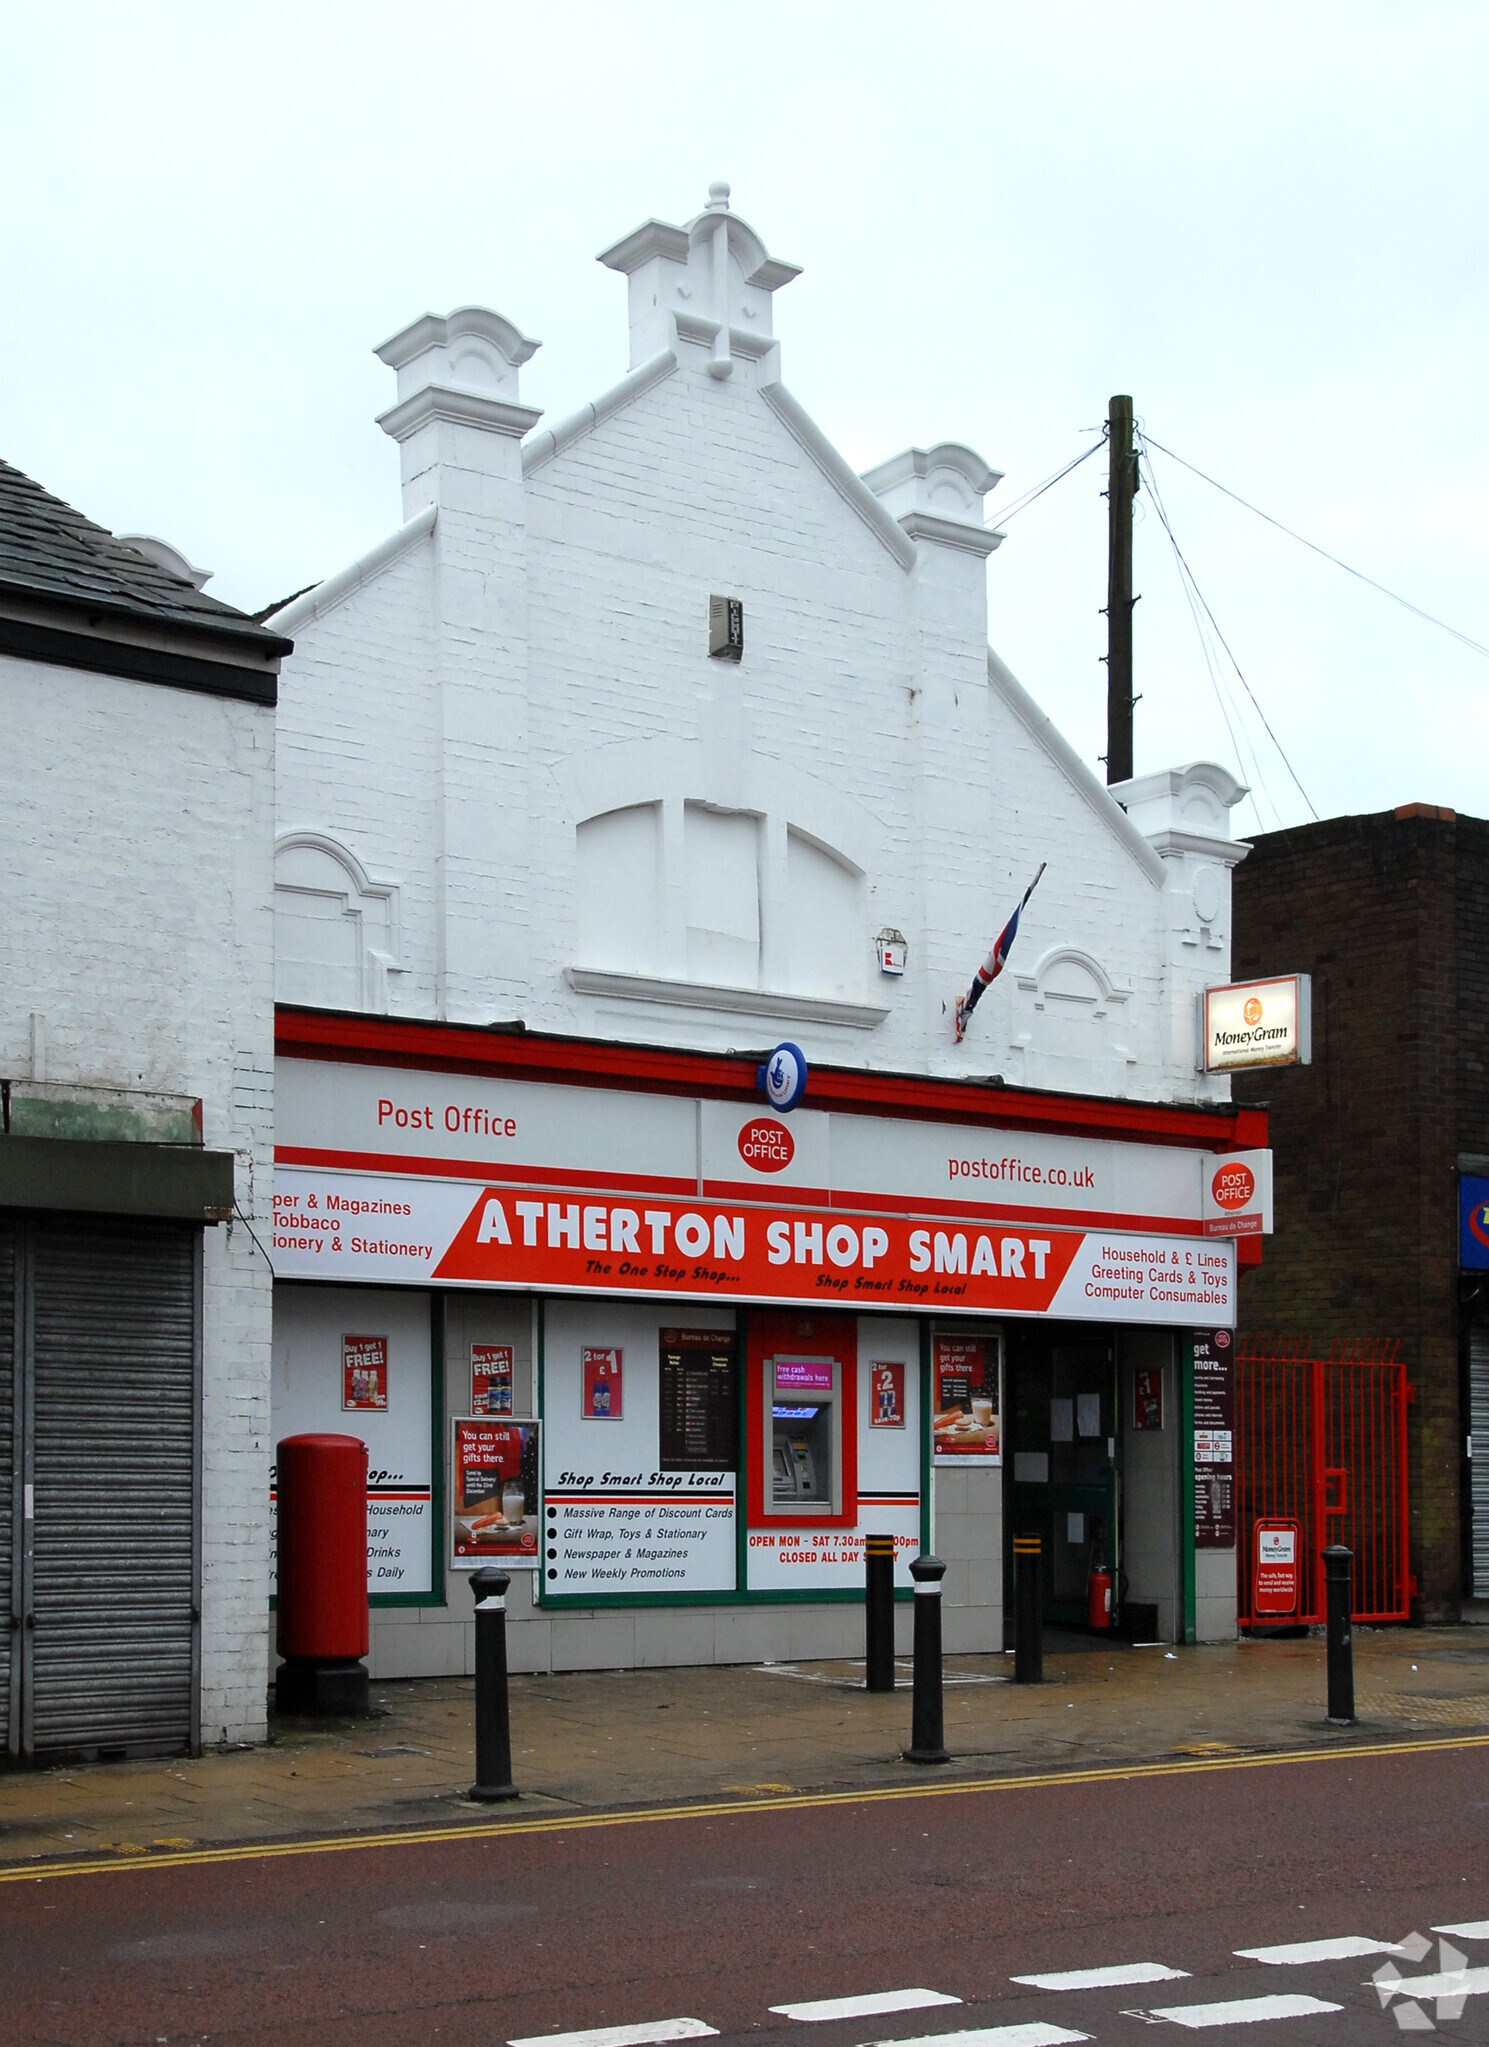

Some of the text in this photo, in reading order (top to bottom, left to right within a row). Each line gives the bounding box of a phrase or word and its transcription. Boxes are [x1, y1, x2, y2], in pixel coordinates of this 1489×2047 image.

[1214, 1027, 1288, 1046] MoneyGram
[378, 1099, 517, 1137] Post Office
[751, 1128, 784, 1144] POST
[743, 1143, 788, 1160] OFFICE
[948, 1158, 1095, 1188] postoffice.co.uk
[1221, 1173, 1247, 1187] POST
[1216, 1186, 1251, 1201] OFFICE
[272, 1193, 411, 1216] per & Magazines
[272, 1212, 341, 1231] Tobbaco
[1209, 1221, 1257, 1232] Bureau de Change
[476, 1198, 1051, 1279] ATHERTON SHOP SMART
[273, 1233, 433, 1260] ionery & Stationery
[1102, 1246, 1228, 1268] Household & £ Lines
[586, 1260, 741, 1284] The One Stop Shop...
[1091, 1264, 1228, 1288] Greeting Cards & Toys
[816, 1274, 967, 1296] Shop Smart Shop Local
[1085, 1283, 1228, 1305] Computer Consumables
[681, 1332, 702, 1341] Bureau
[710, 1334, 731, 1344] Change
[343, 1344, 358, 1353] Buy
[364, 1342, 376, 1352] get
[939, 1343, 976, 1353] You can still
[1193, 1343, 1210, 1357] get
[346, 1351, 384, 1368] FREE!
[584, 1351, 592, 1361] 2
[940, 1354, 966, 1363] get your
[474, 1360, 510, 1376] FREE!
[777, 1364, 805, 1373] free cash
[872, 1363, 877, 1371] 2
[940, 1363, 954, 1373] gifts
[1194, 1360, 1228, 1371] more...
[777, 1373, 829, 1382] withdrawals here
[462, 1430, 510, 1441] You can still
[463, 1443, 495, 1453] get your
[463, 1454, 481, 1464] gifts
[558, 1472, 725, 1489] Shop Smart Shop Local
[1194, 1473, 1216, 1482] opening
[366, 1505, 424, 1515] Household
[563, 1507, 733, 1520] Massive Range of Discount Cards
[563, 1528, 707, 1540] Gift Wrap, Toys & Stationary
[749, 1536, 775, 1547] OPEN
[779, 1536, 800, 1546] MON
[812, 1536, 830, 1546] SAT
[833, 1535, 867, 1547] 7.30am
[893, 1536, 919, 1548] 00pm
[367, 1547, 401, 1557] Drinks
[563, 1548, 689, 1560] Newspaper & Magazines
[1262, 1545, 1291, 1553] MoneyGram
[779, 1552, 817, 1563] CLOSED
[821, 1552, 838, 1562] ALL
[841, 1552, 859, 1562] DAY
[377, 1566, 405, 1579] Daily
[564, 1568, 686, 1580] New Weekly Promotions
